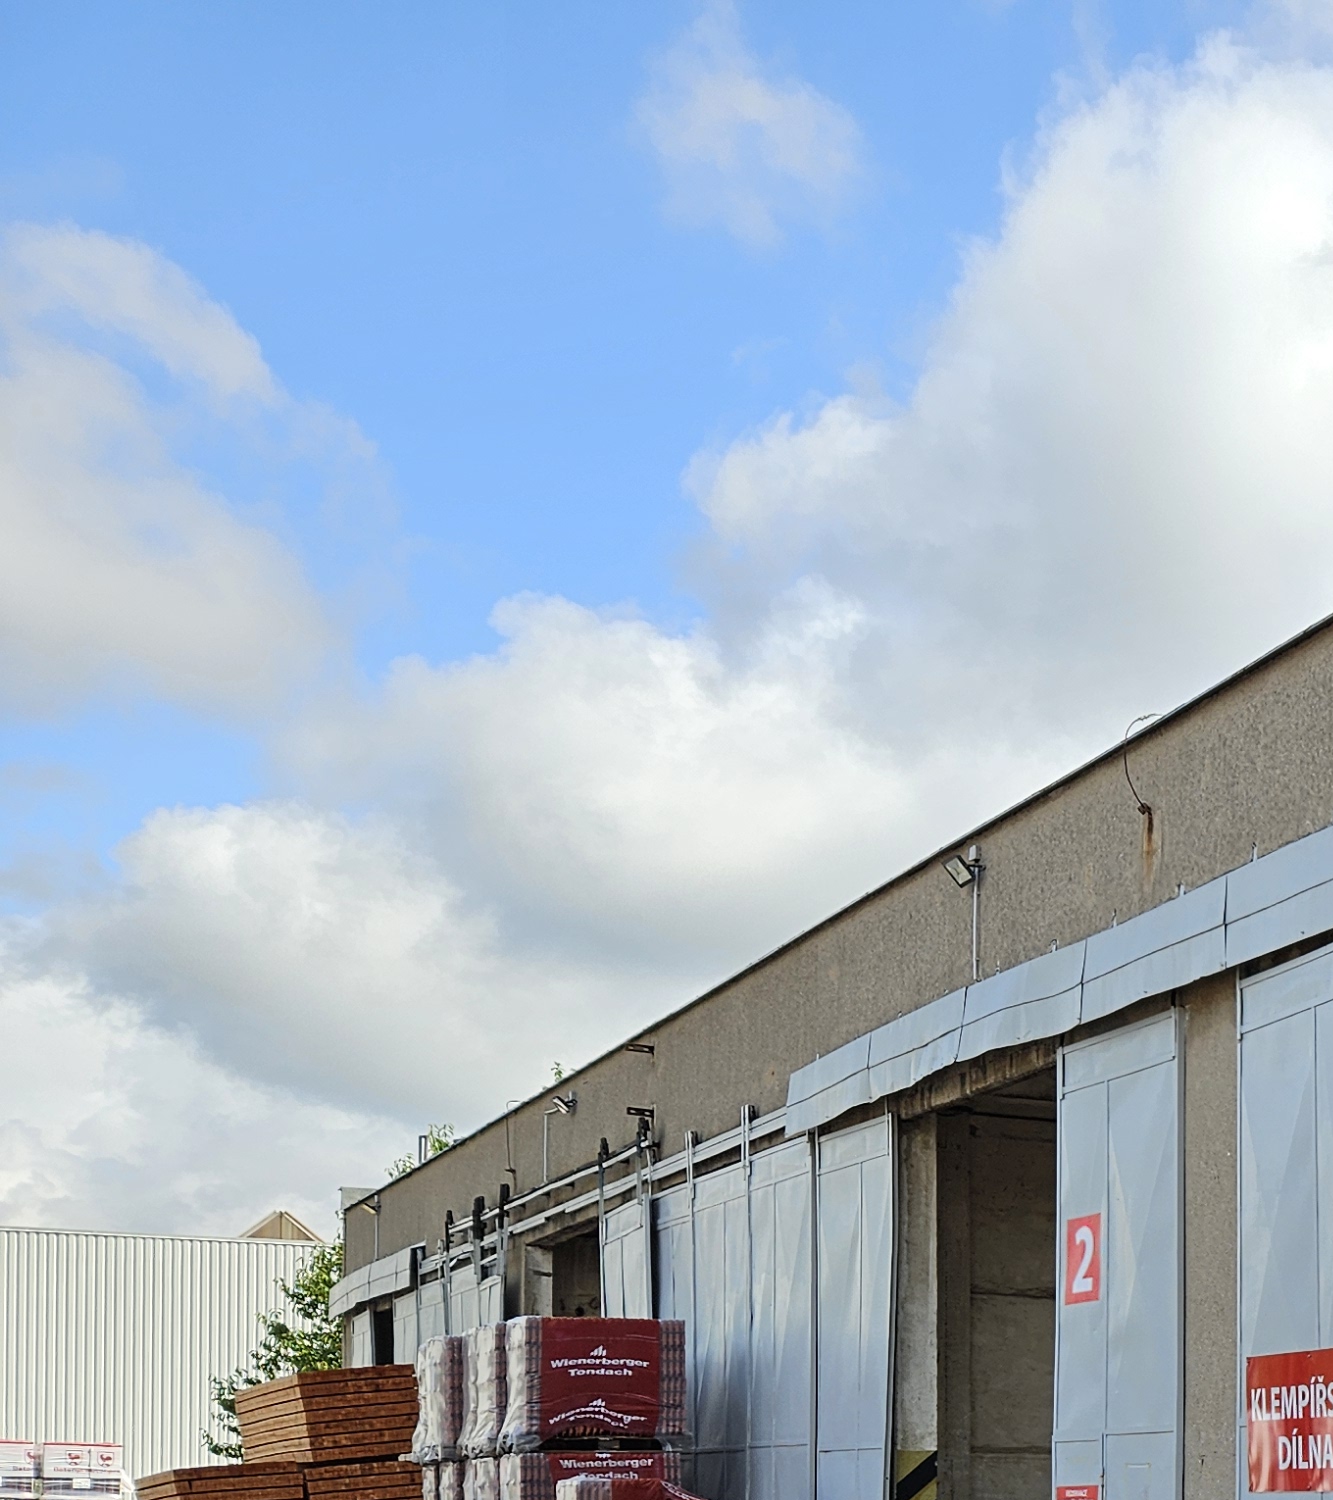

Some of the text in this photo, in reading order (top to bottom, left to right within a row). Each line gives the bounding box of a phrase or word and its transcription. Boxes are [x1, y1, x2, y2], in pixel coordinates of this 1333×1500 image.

[1071, 1225, 1095, 1294] 2
[550, 1357, 650, 1368] Wienerberger
[568, 1368, 633, 1377] Tondach
[559, 1457, 654, 1469] Wienerberger
